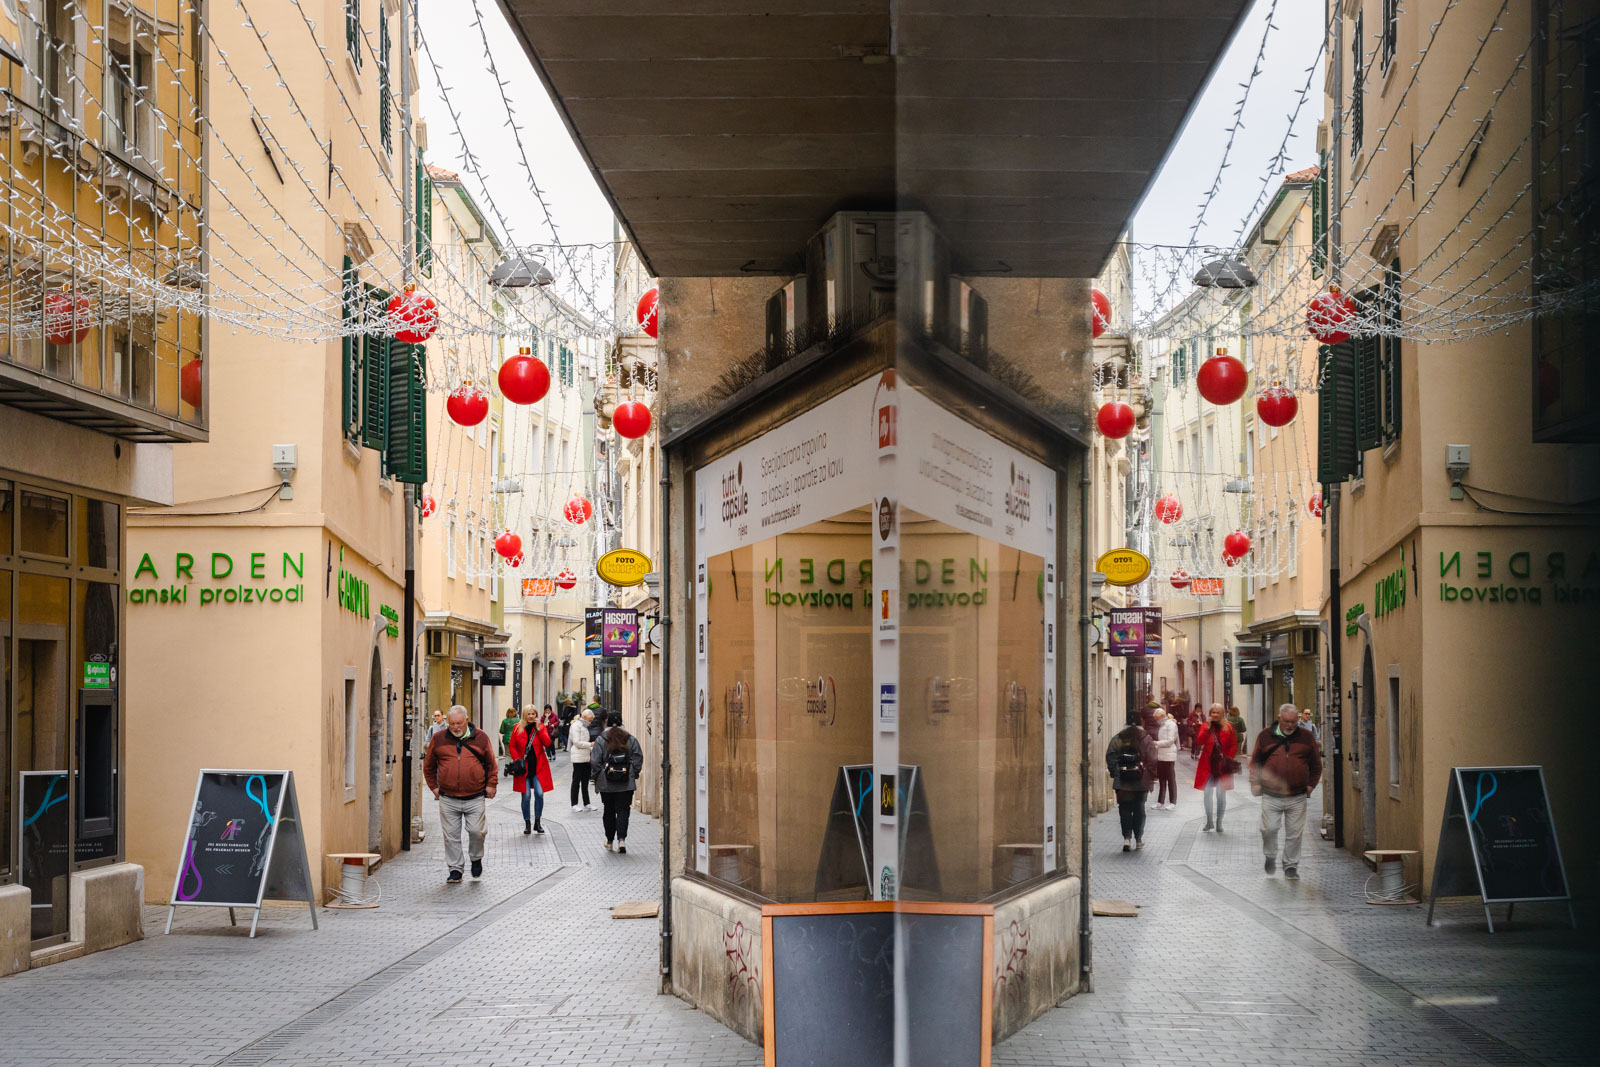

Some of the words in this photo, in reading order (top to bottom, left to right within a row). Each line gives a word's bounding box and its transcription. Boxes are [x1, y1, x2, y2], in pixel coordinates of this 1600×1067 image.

[802, 430, 827, 465] trgovina
[761, 490, 767, 507] za
[768, 476, 790, 508] kapsule
[794, 467, 818, 498] aparate
[819, 464, 826, 483] za
[828, 456, 844, 479] kavu
[722, 485, 749, 528] capsule
[134, 552, 303, 579] ARDEN
[125, 585, 187, 604] anski
[605, 613, 636, 624] HGSPOT
